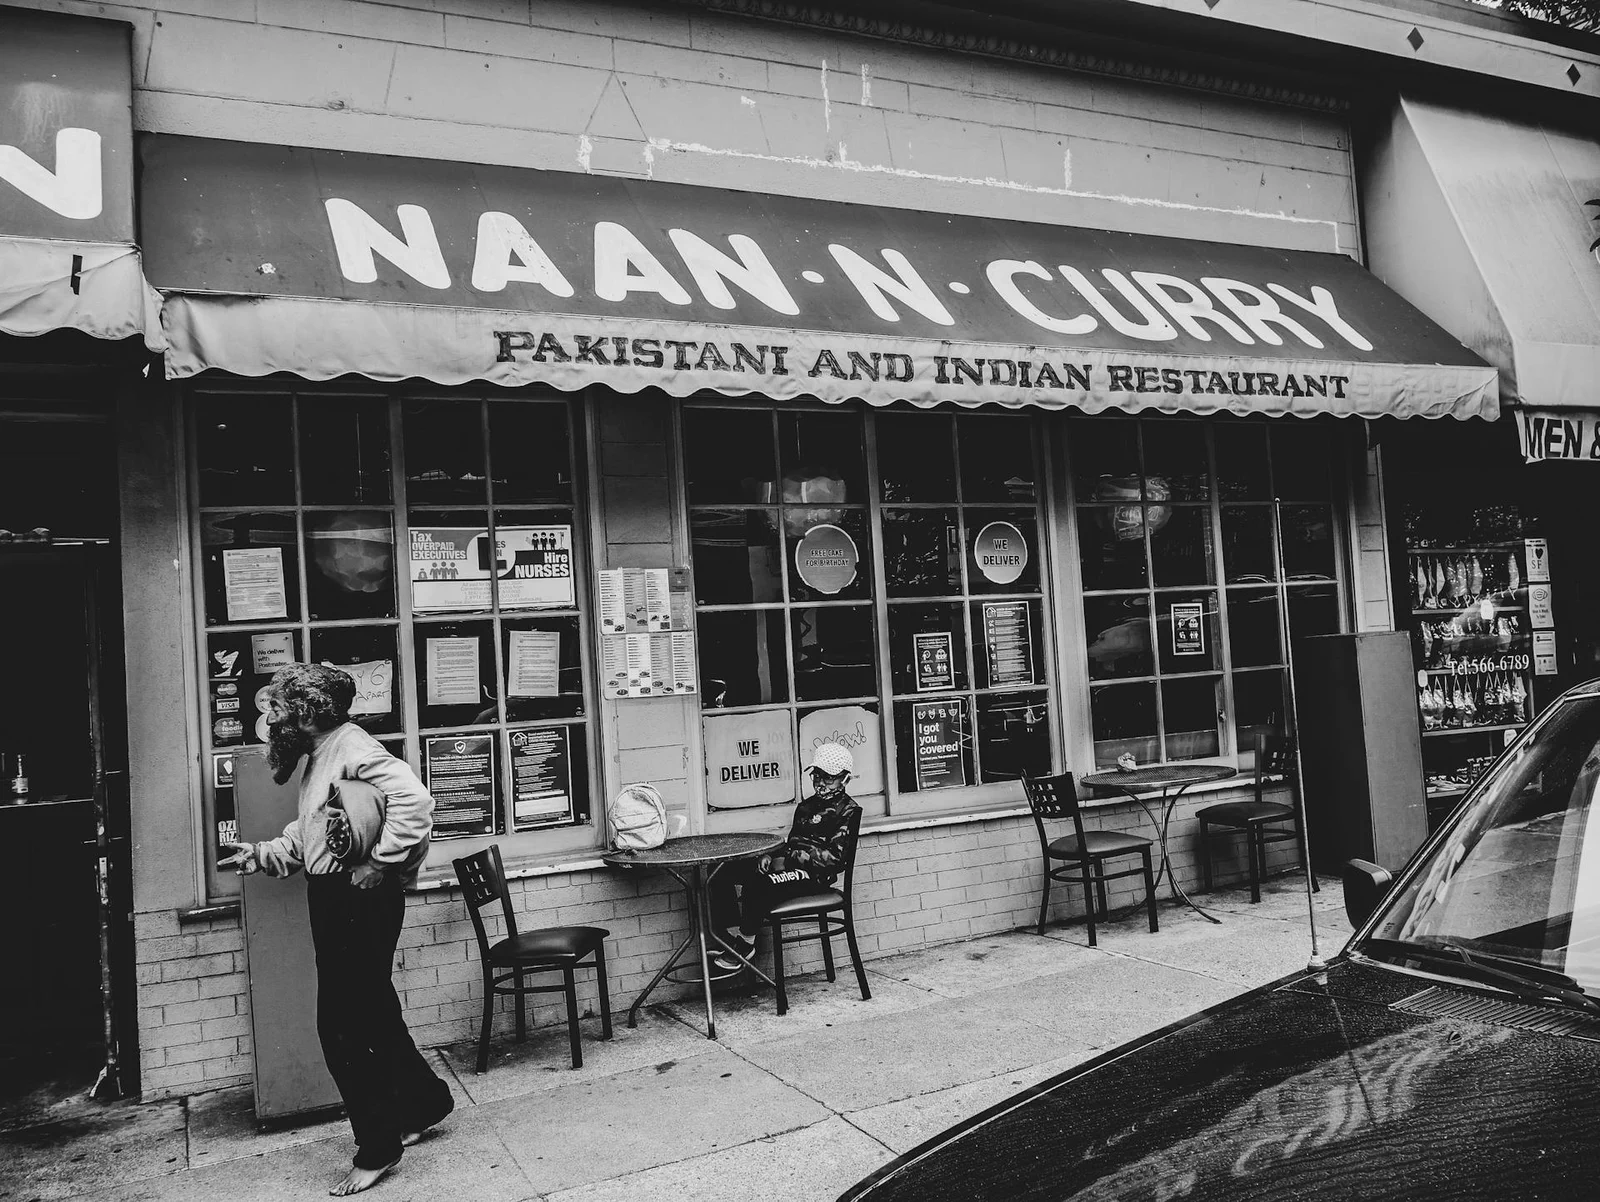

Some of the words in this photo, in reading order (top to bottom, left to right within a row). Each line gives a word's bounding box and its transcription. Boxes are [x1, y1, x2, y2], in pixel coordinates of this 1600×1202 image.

[324, 197, 799, 315] NAAN
[828, 243, 955, 326] N
[986, 259, 1374, 351] CURRY
[493, 330, 789, 375] PAKISTANI
[808, 349, 914, 383] AND
[934, 356, 1093, 391] INDIAN
[1106, 364, 1350, 399] RESTAURANT
[1525, 416, 1583, 459] MEN
[411, 531, 432, 542] Tax
[412, 541, 455, 551] OVERPAID
[992, 538, 1008, 551] WE
[412, 550, 467, 560] EXECUTIVES
[544, 551, 568, 564] Hire
[810, 548, 827, 557] FREE
[983, 554, 1021, 566] DELIVER
[514, 563, 570, 579] NURSES
[1448, 653, 1530, 677] Tel:566-6789
[918, 723, 922, 734] I
[923, 722, 940, 735] got
[919, 735, 938, 747] you
[737, 740, 760, 757] WE
[919, 741, 959, 755] covered
[721, 761, 780, 783] DELIVER
[768, 870, 800, 884] Hurley
